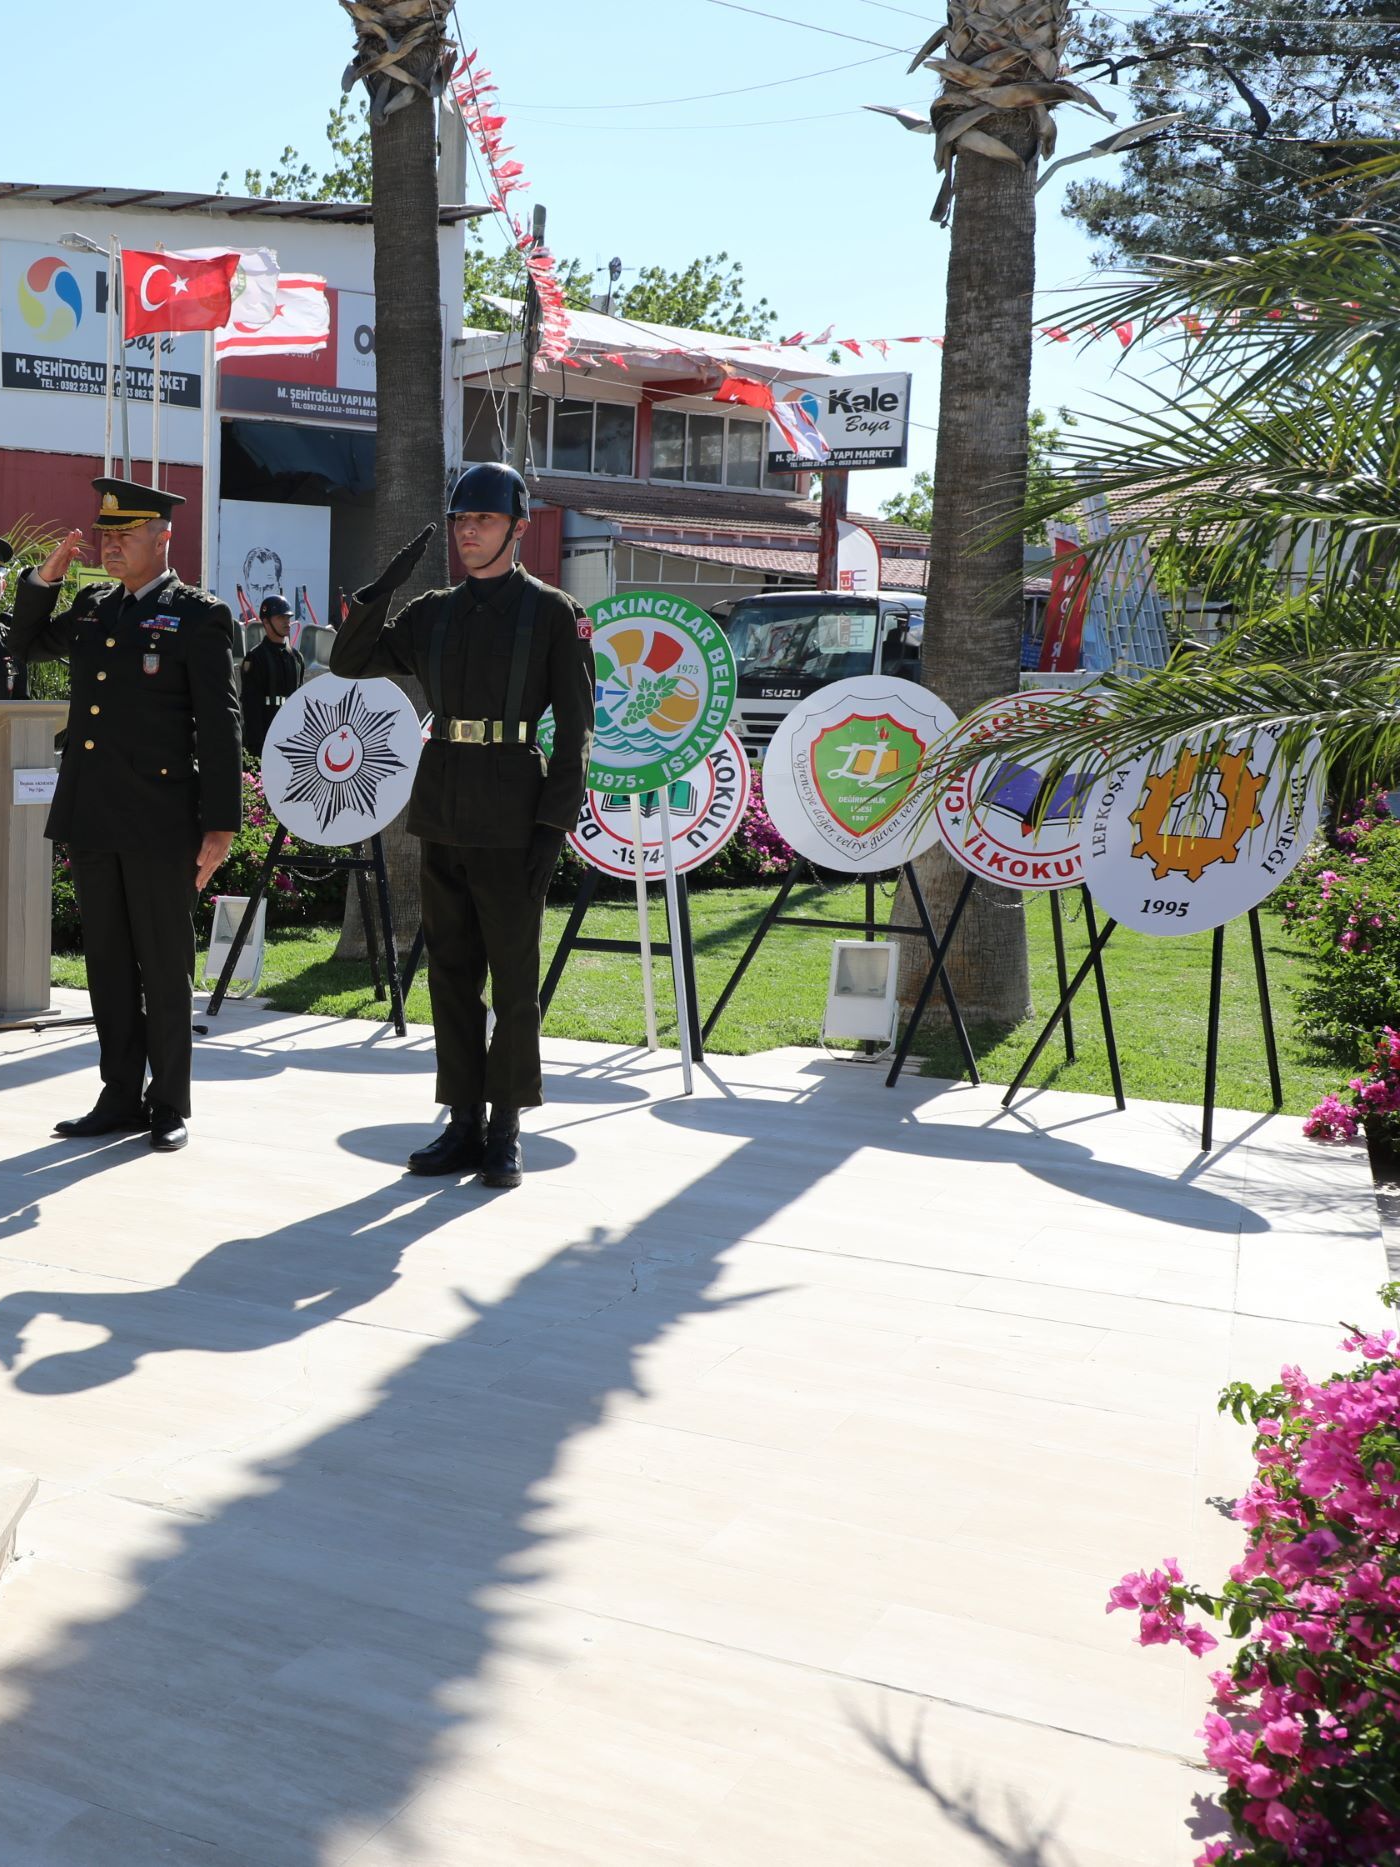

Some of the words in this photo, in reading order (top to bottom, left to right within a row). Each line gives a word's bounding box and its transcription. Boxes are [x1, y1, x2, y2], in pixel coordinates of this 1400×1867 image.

[15, 357, 30, 373] M.
[33, 359, 104, 382] ŞEHİTOĞLU
[111, 369, 135, 386] API
[41, 378, 55, 389] TEL
[60, 382, 78, 392] 0392
[79, 383, 88, 393] 23
[89, 384, 99, 394] 24
[116, 387, 134, 397] 033
[134, 389, 147, 399] 862
[277, 387, 288, 398] M.
[290, 387, 339, 403] ŞEHİTOĞLU
[340, 394, 361, 405] YAPI
[828, 387, 899, 414] Kale
[845, 415, 892, 436] Boya
[833, 450, 853, 460] YAPI
[855, 449, 895, 459] MARKET
[676, 664, 699, 675] 1975
[595, 597, 715, 647] AKINCILAR
[661, 648, 731, 780] BELEDİYESİ
[761, 688, 801, 698] ISUZU
[1092, 767, 1131, 858] LEFKOŞA
[1140, 899, 1190, 917] 1995
